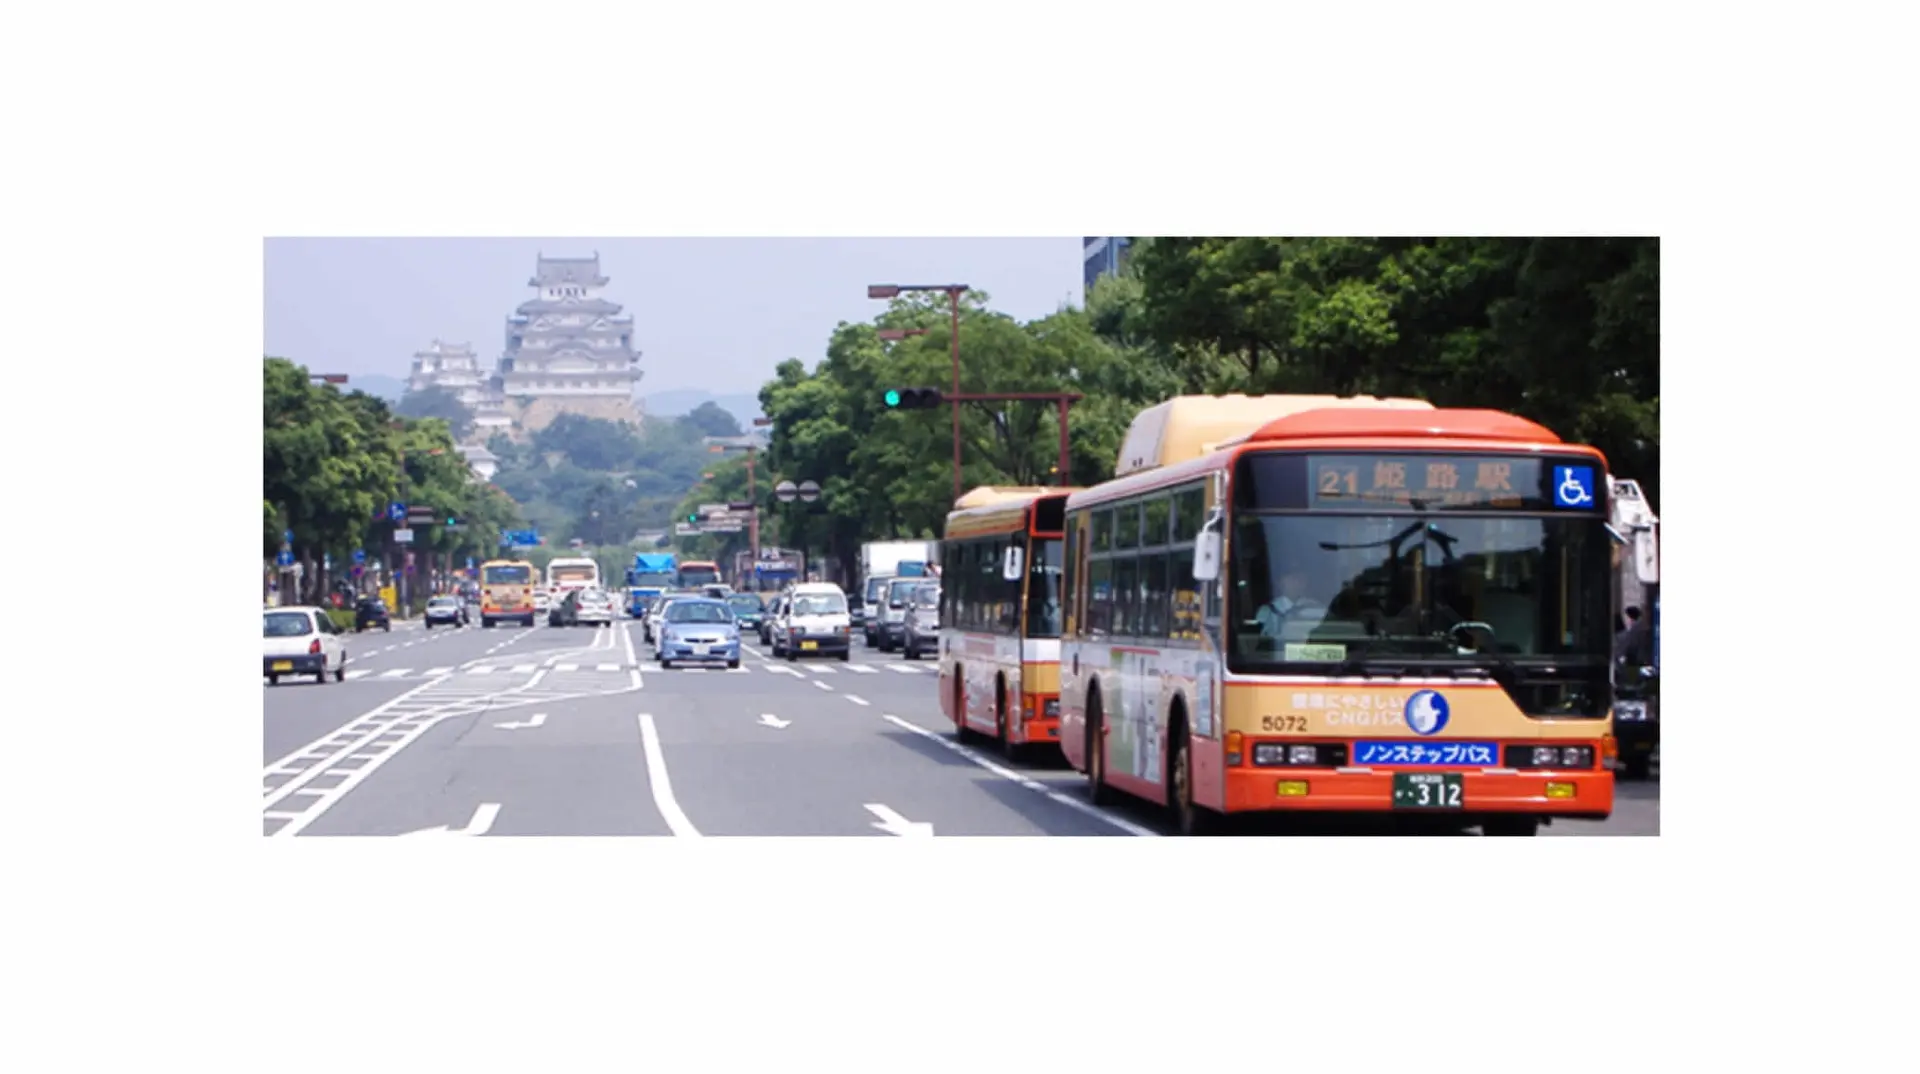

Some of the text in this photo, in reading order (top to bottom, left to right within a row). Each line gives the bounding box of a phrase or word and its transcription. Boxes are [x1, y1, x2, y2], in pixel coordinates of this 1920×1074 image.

[1322, 471, 1357, 493] 21
[1262, 715, 1308, 732] 5072
[1362, 744, 1491, 763] ノンステップバス
